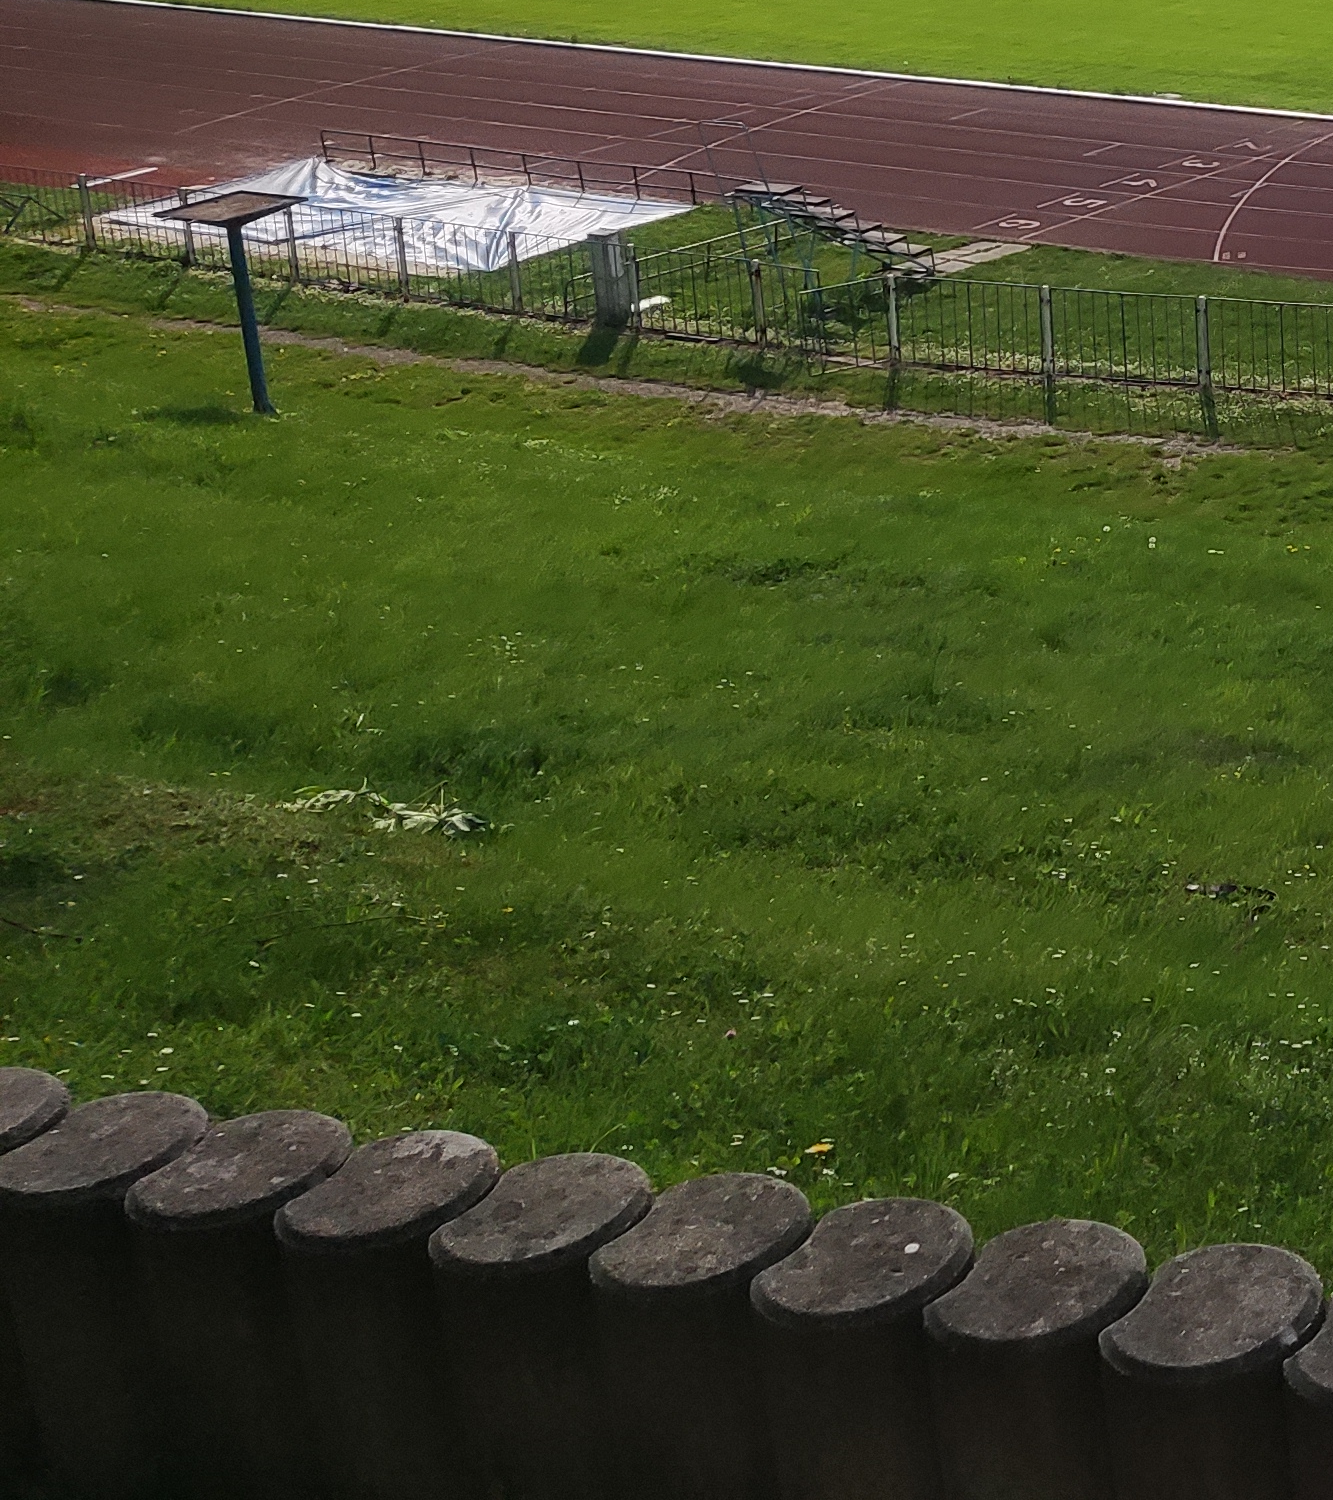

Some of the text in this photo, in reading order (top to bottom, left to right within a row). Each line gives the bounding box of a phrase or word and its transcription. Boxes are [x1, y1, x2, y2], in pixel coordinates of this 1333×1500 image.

[1181, 159, 1220, 168] 3
[1062, 197, 1107, 209] 5
[998, 219, 1041, 230] 6
